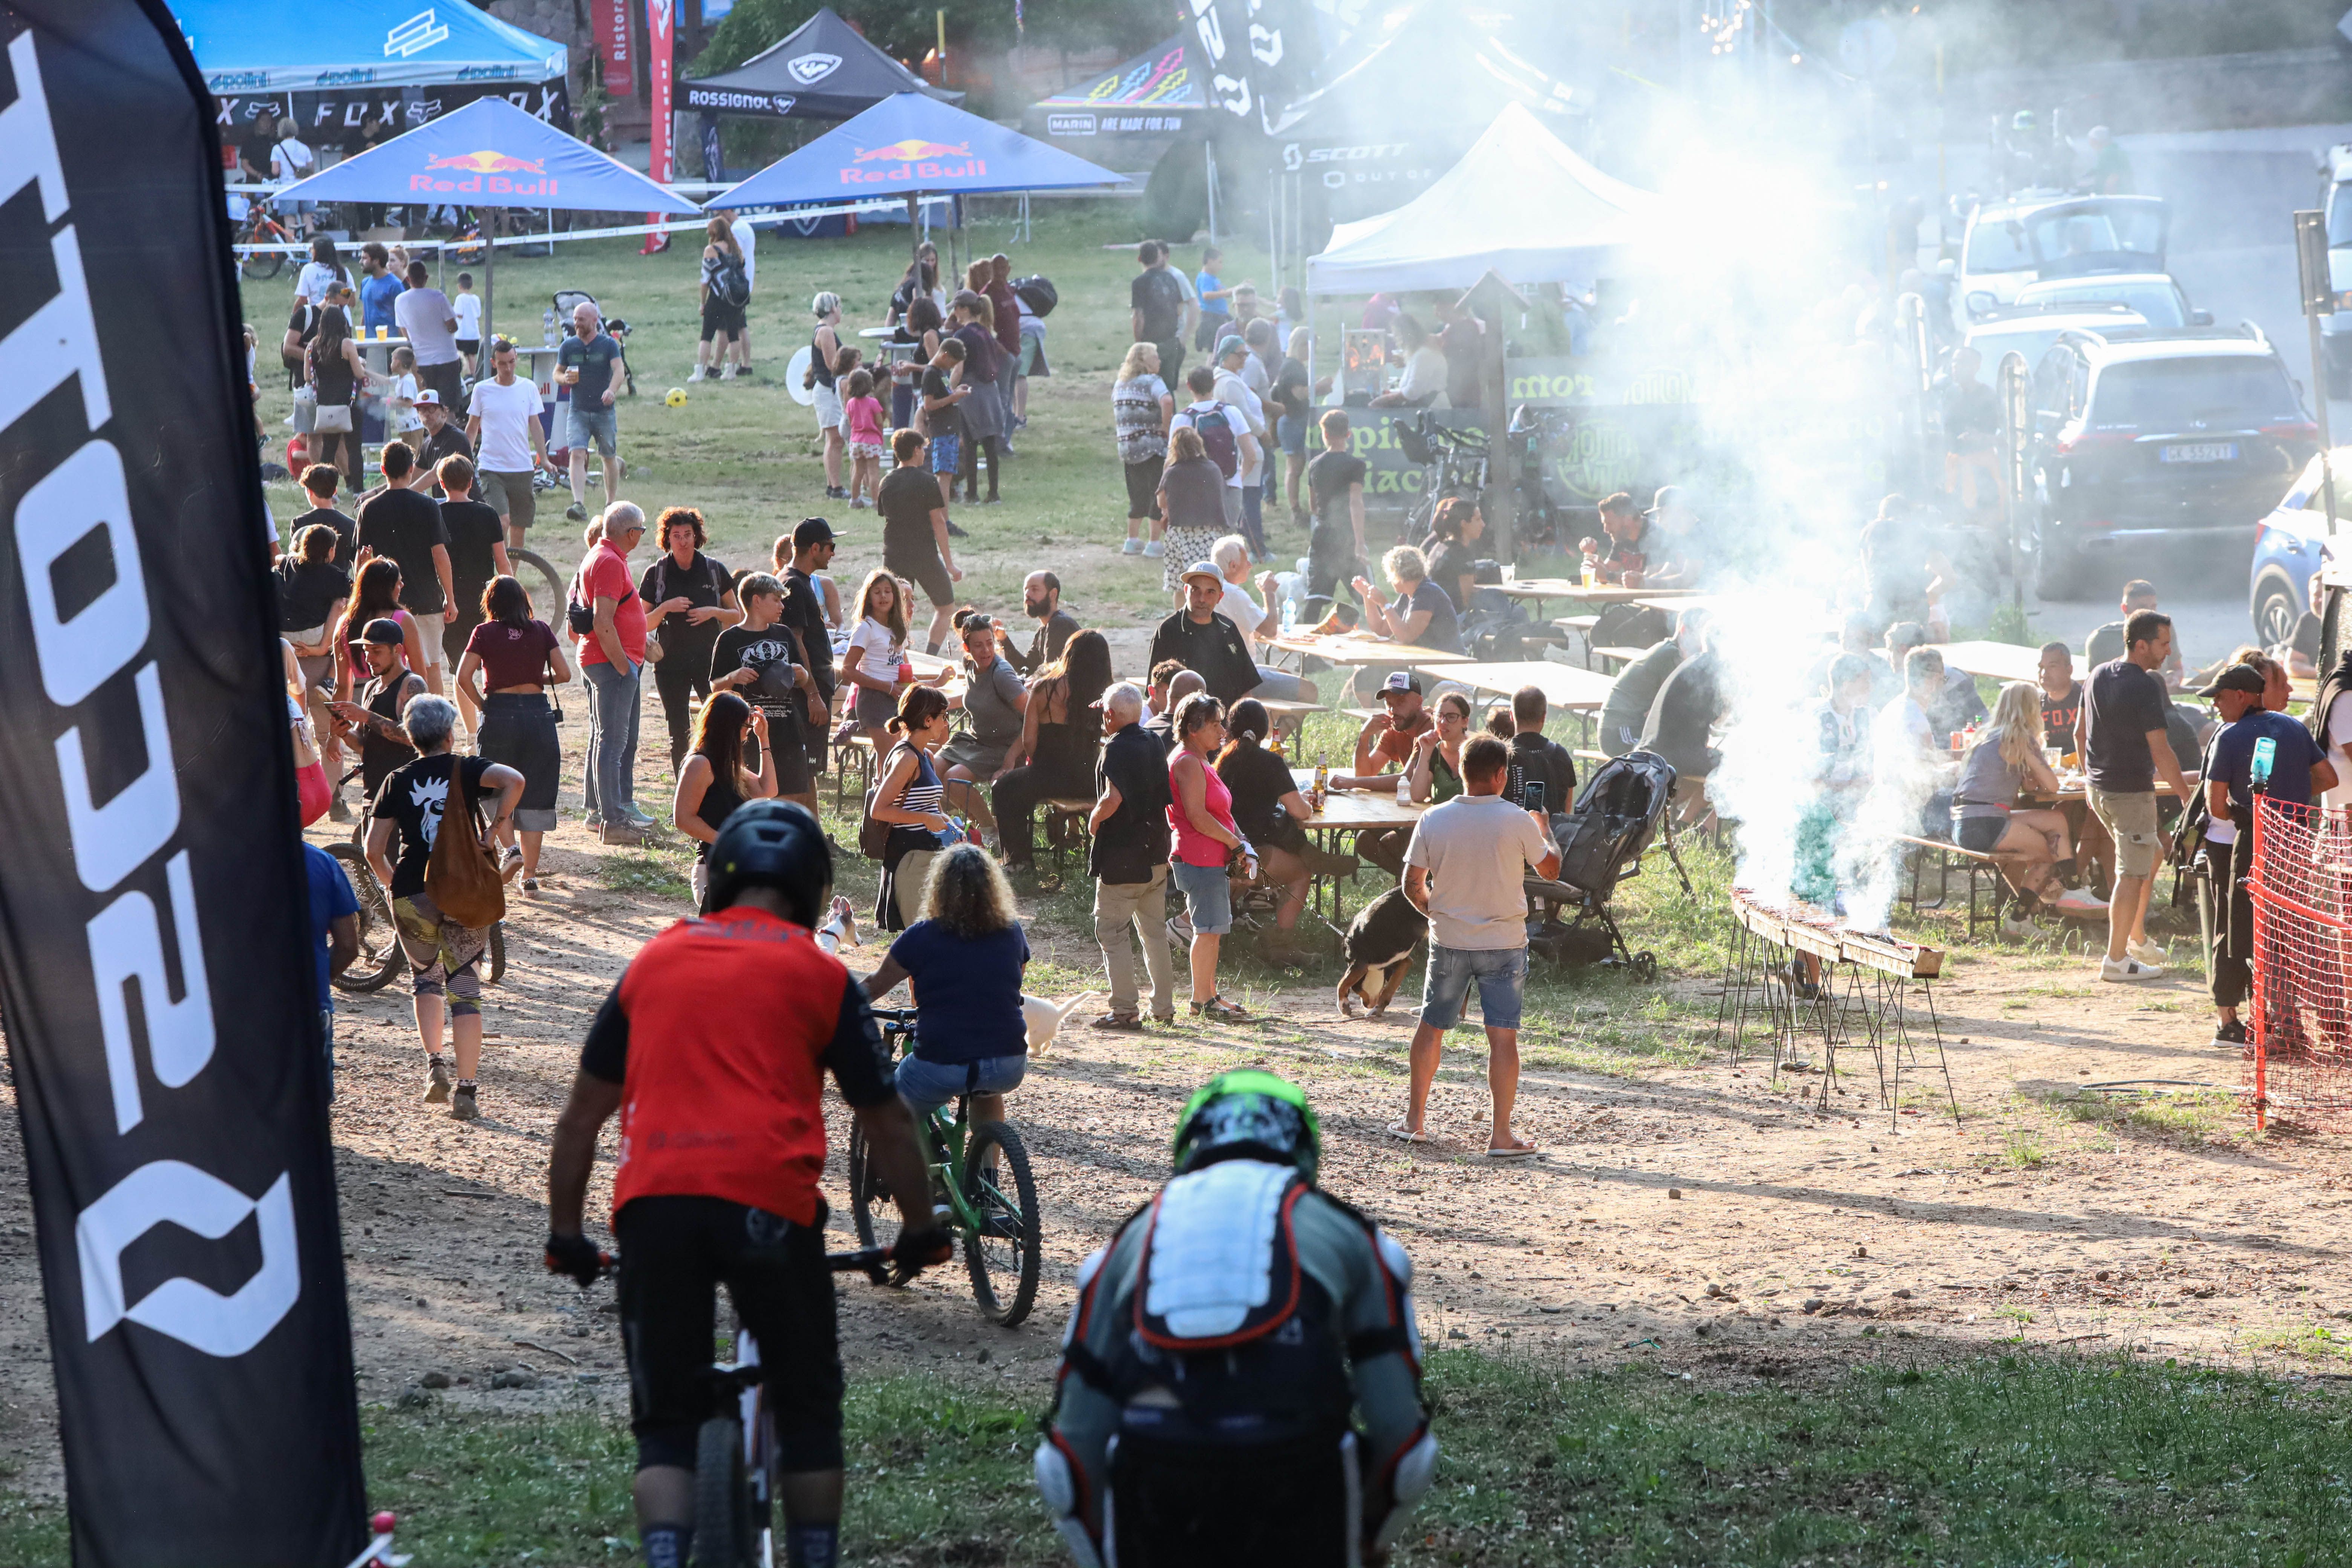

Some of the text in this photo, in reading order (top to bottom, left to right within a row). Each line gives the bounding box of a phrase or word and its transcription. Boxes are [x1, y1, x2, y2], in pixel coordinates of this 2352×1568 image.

[508, 92, 559, 119] OX
[689, 90, 773, 110] ROSSIGNOL
[314, 100, 401, 127] FOX
[1052, 119, 1092, 129] MARIN
[1101, 117, 1182, 131] ARE MADE FOR FUN
[1306, 142, 1410, 163] SCOTT
[840, 160, 987, 184] Red Bull
[1355, 168, 1433, 183] OUT OF
[410, 175, 558, 196] Red Bull
[2041, 707, 2078, 726] FOX
